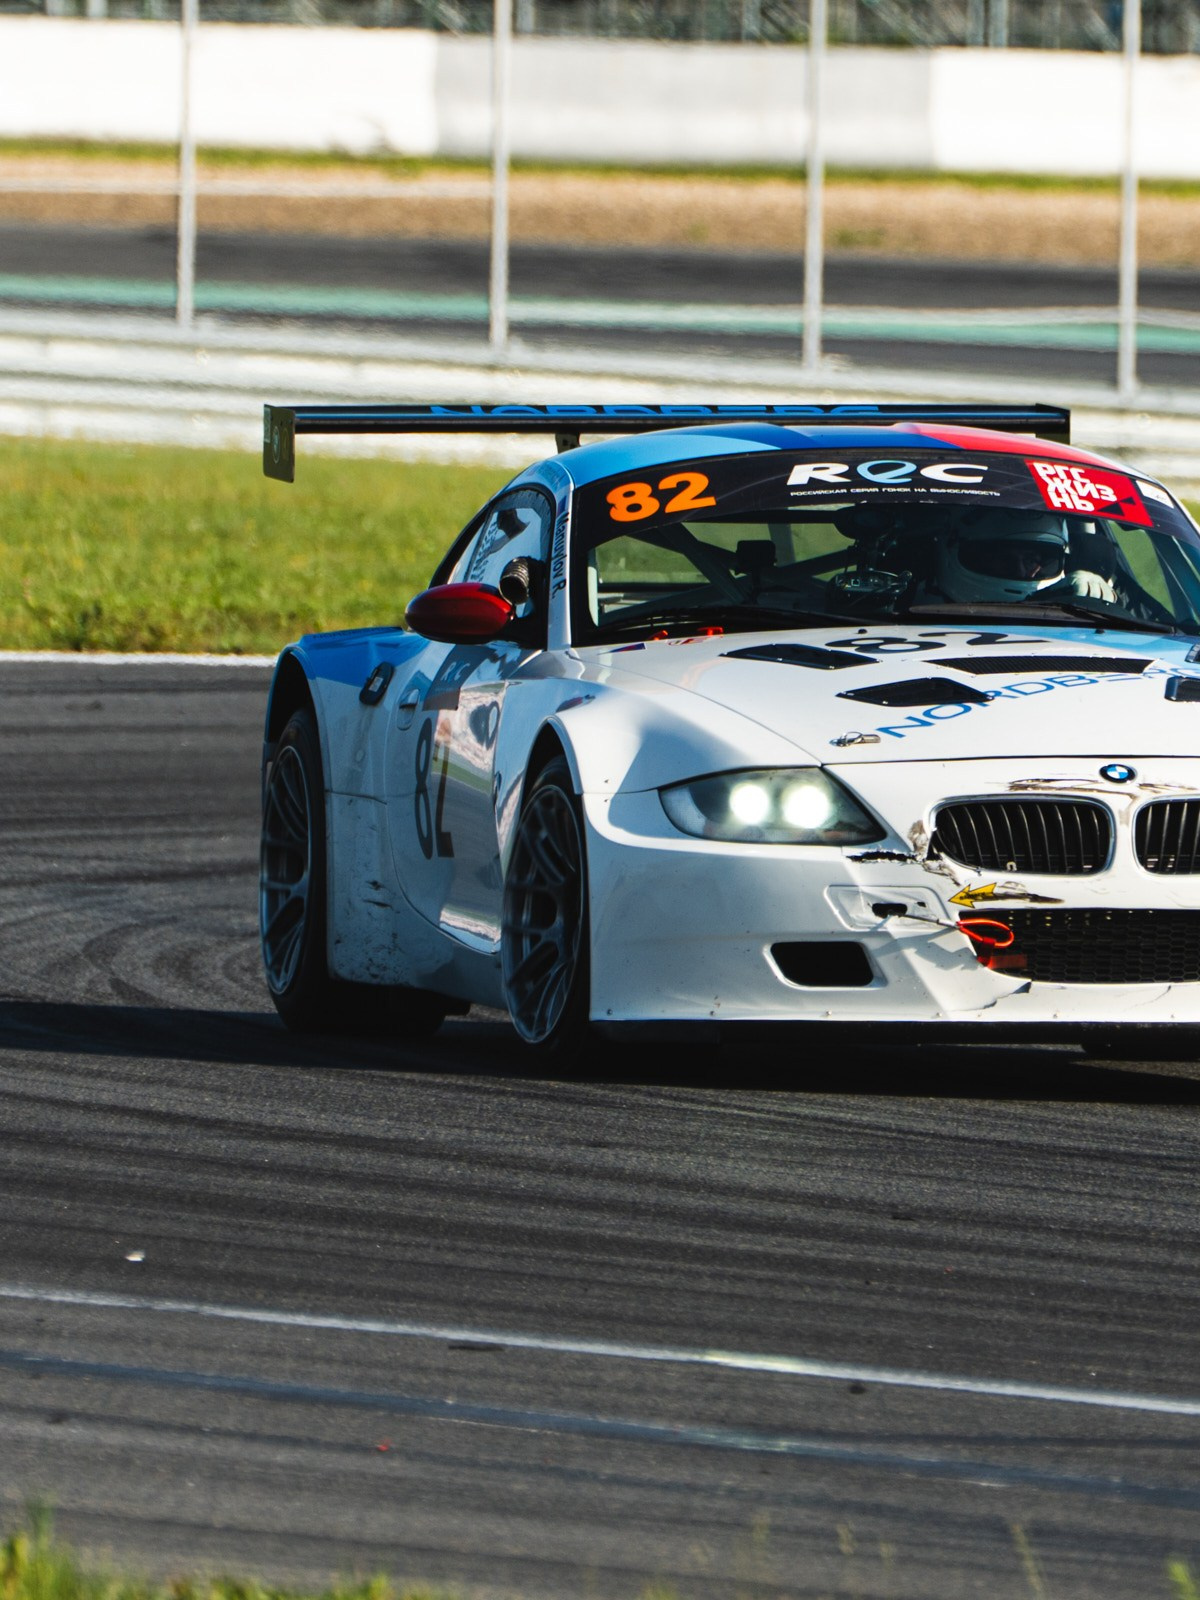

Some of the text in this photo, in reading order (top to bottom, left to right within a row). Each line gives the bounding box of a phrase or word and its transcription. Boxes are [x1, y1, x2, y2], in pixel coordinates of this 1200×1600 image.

[1032, 462, 1091, 483] РГС
[606, 472, 716, 522] 82
[824, 631, 1052, 654] 82
